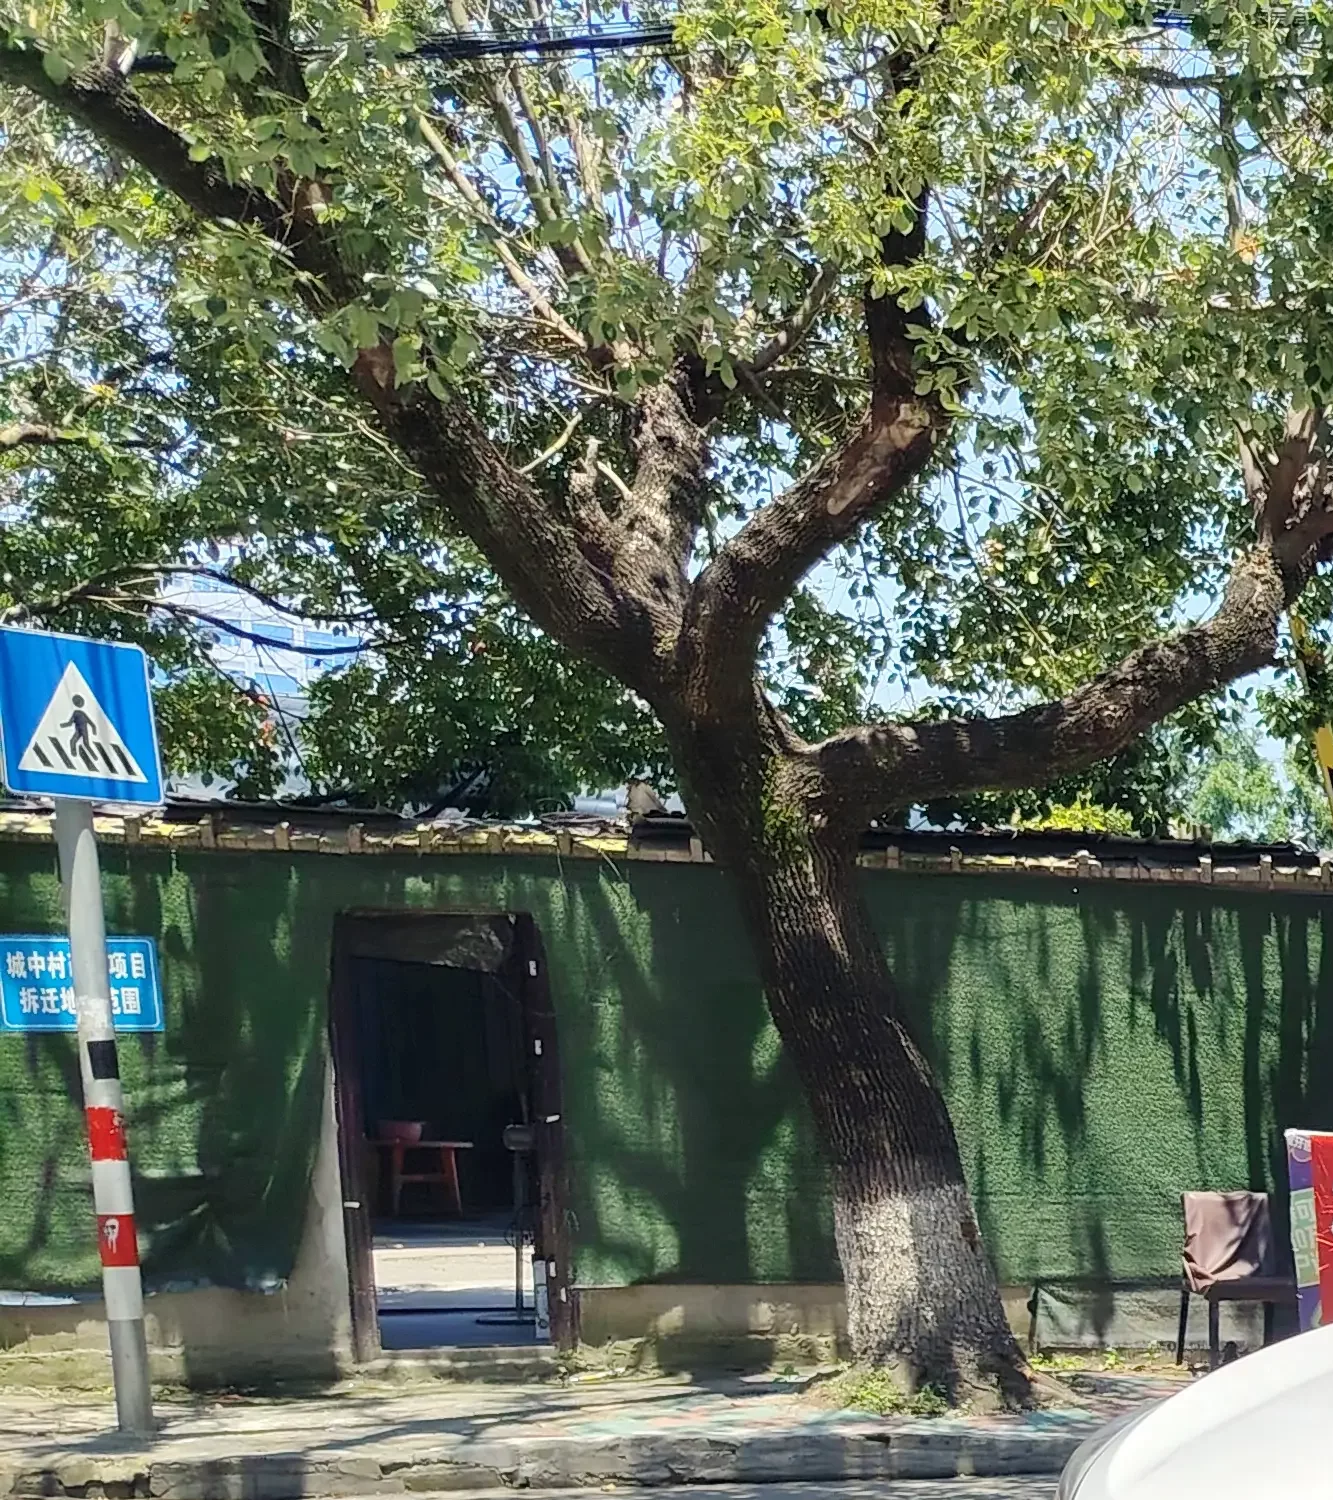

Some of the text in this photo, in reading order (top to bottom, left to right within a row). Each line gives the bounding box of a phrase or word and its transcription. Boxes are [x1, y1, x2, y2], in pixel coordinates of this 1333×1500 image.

[6, 950, 146, 979] 城中村项目
[19, 986, 141, 1014] 拆迁地围
